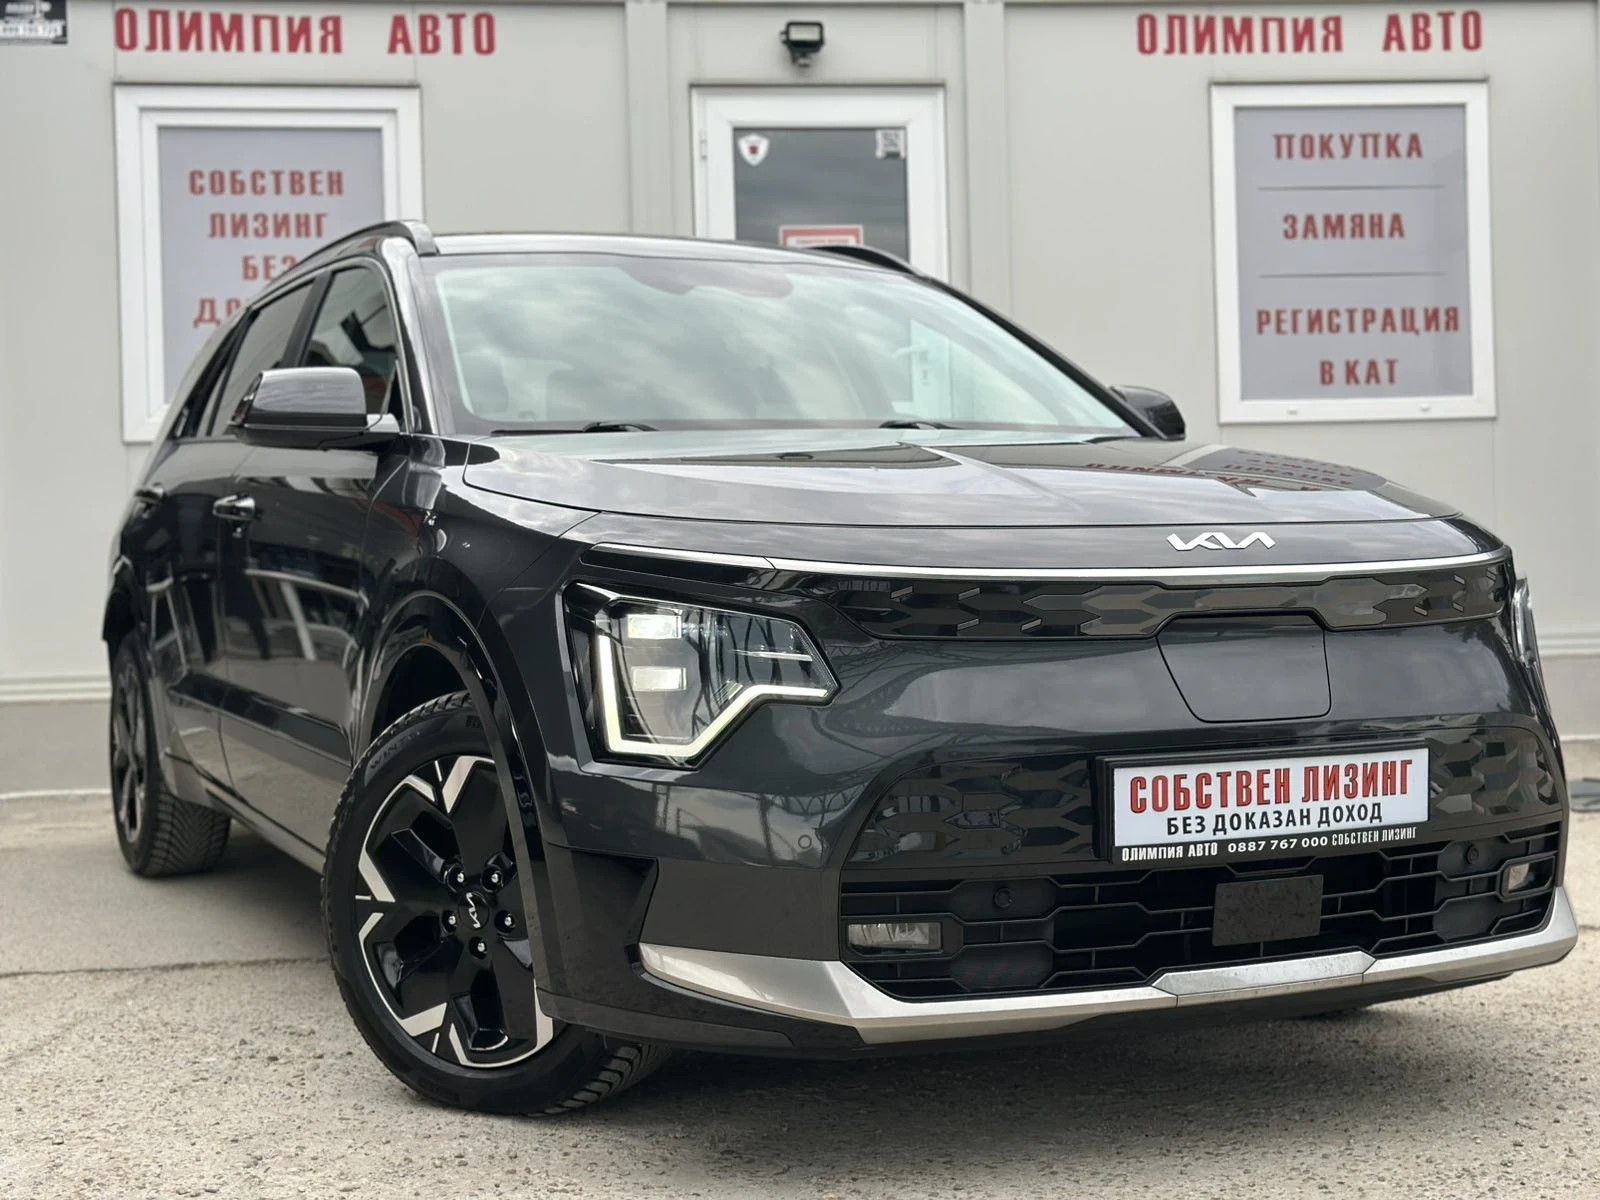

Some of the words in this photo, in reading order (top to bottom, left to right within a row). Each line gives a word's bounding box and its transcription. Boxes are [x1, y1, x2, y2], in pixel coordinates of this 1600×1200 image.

[114, 8, 344, 54] ОЛИМПИЯ
[388, 12, 497, 57] АВТО
[1137, 13, 1344, 55] ОЛИМПИЯ
[1383, 10, 1483, 54] АВТО
[1273, 132, 1423, 160] ПОКУПКА
[189, 170, 345, 197] СОБСТВЕН
[208, 213, 328, 240] ЛИЗИНГ
[1283, 213, 1406, 241] ЗАМЯНА
[1256, 307, 1461, 337] РЕГИСТРАЦИЯ
[1320, 361, 1335, 387] В
[1345, 359, 1399, 386] КАТ
[1130, 768, 1291, 814] СОБСТВЕН
[1301, 759, 1413, 803] ЛИЗИНГ
[1167, 815, 1206, 836] БЕЗ
[1212, 808, 1312, 836] ДОКАЗАН
[1317, 802, 1383, 828] ДОХОД
[1121, 845, 1184, 862] ОЛИМПИЯ
[1187, 842, 1219, 858] АВТО
[1227, 840, 1266, 853] 0887
[1270, 838, 1298, 850] 767
[1301, 836, 1329, 848] 000
[1331, 830, 1380, 847] СОБСТВЕН
[1381, 826, 1418, 843] ЛИЗИНГ
